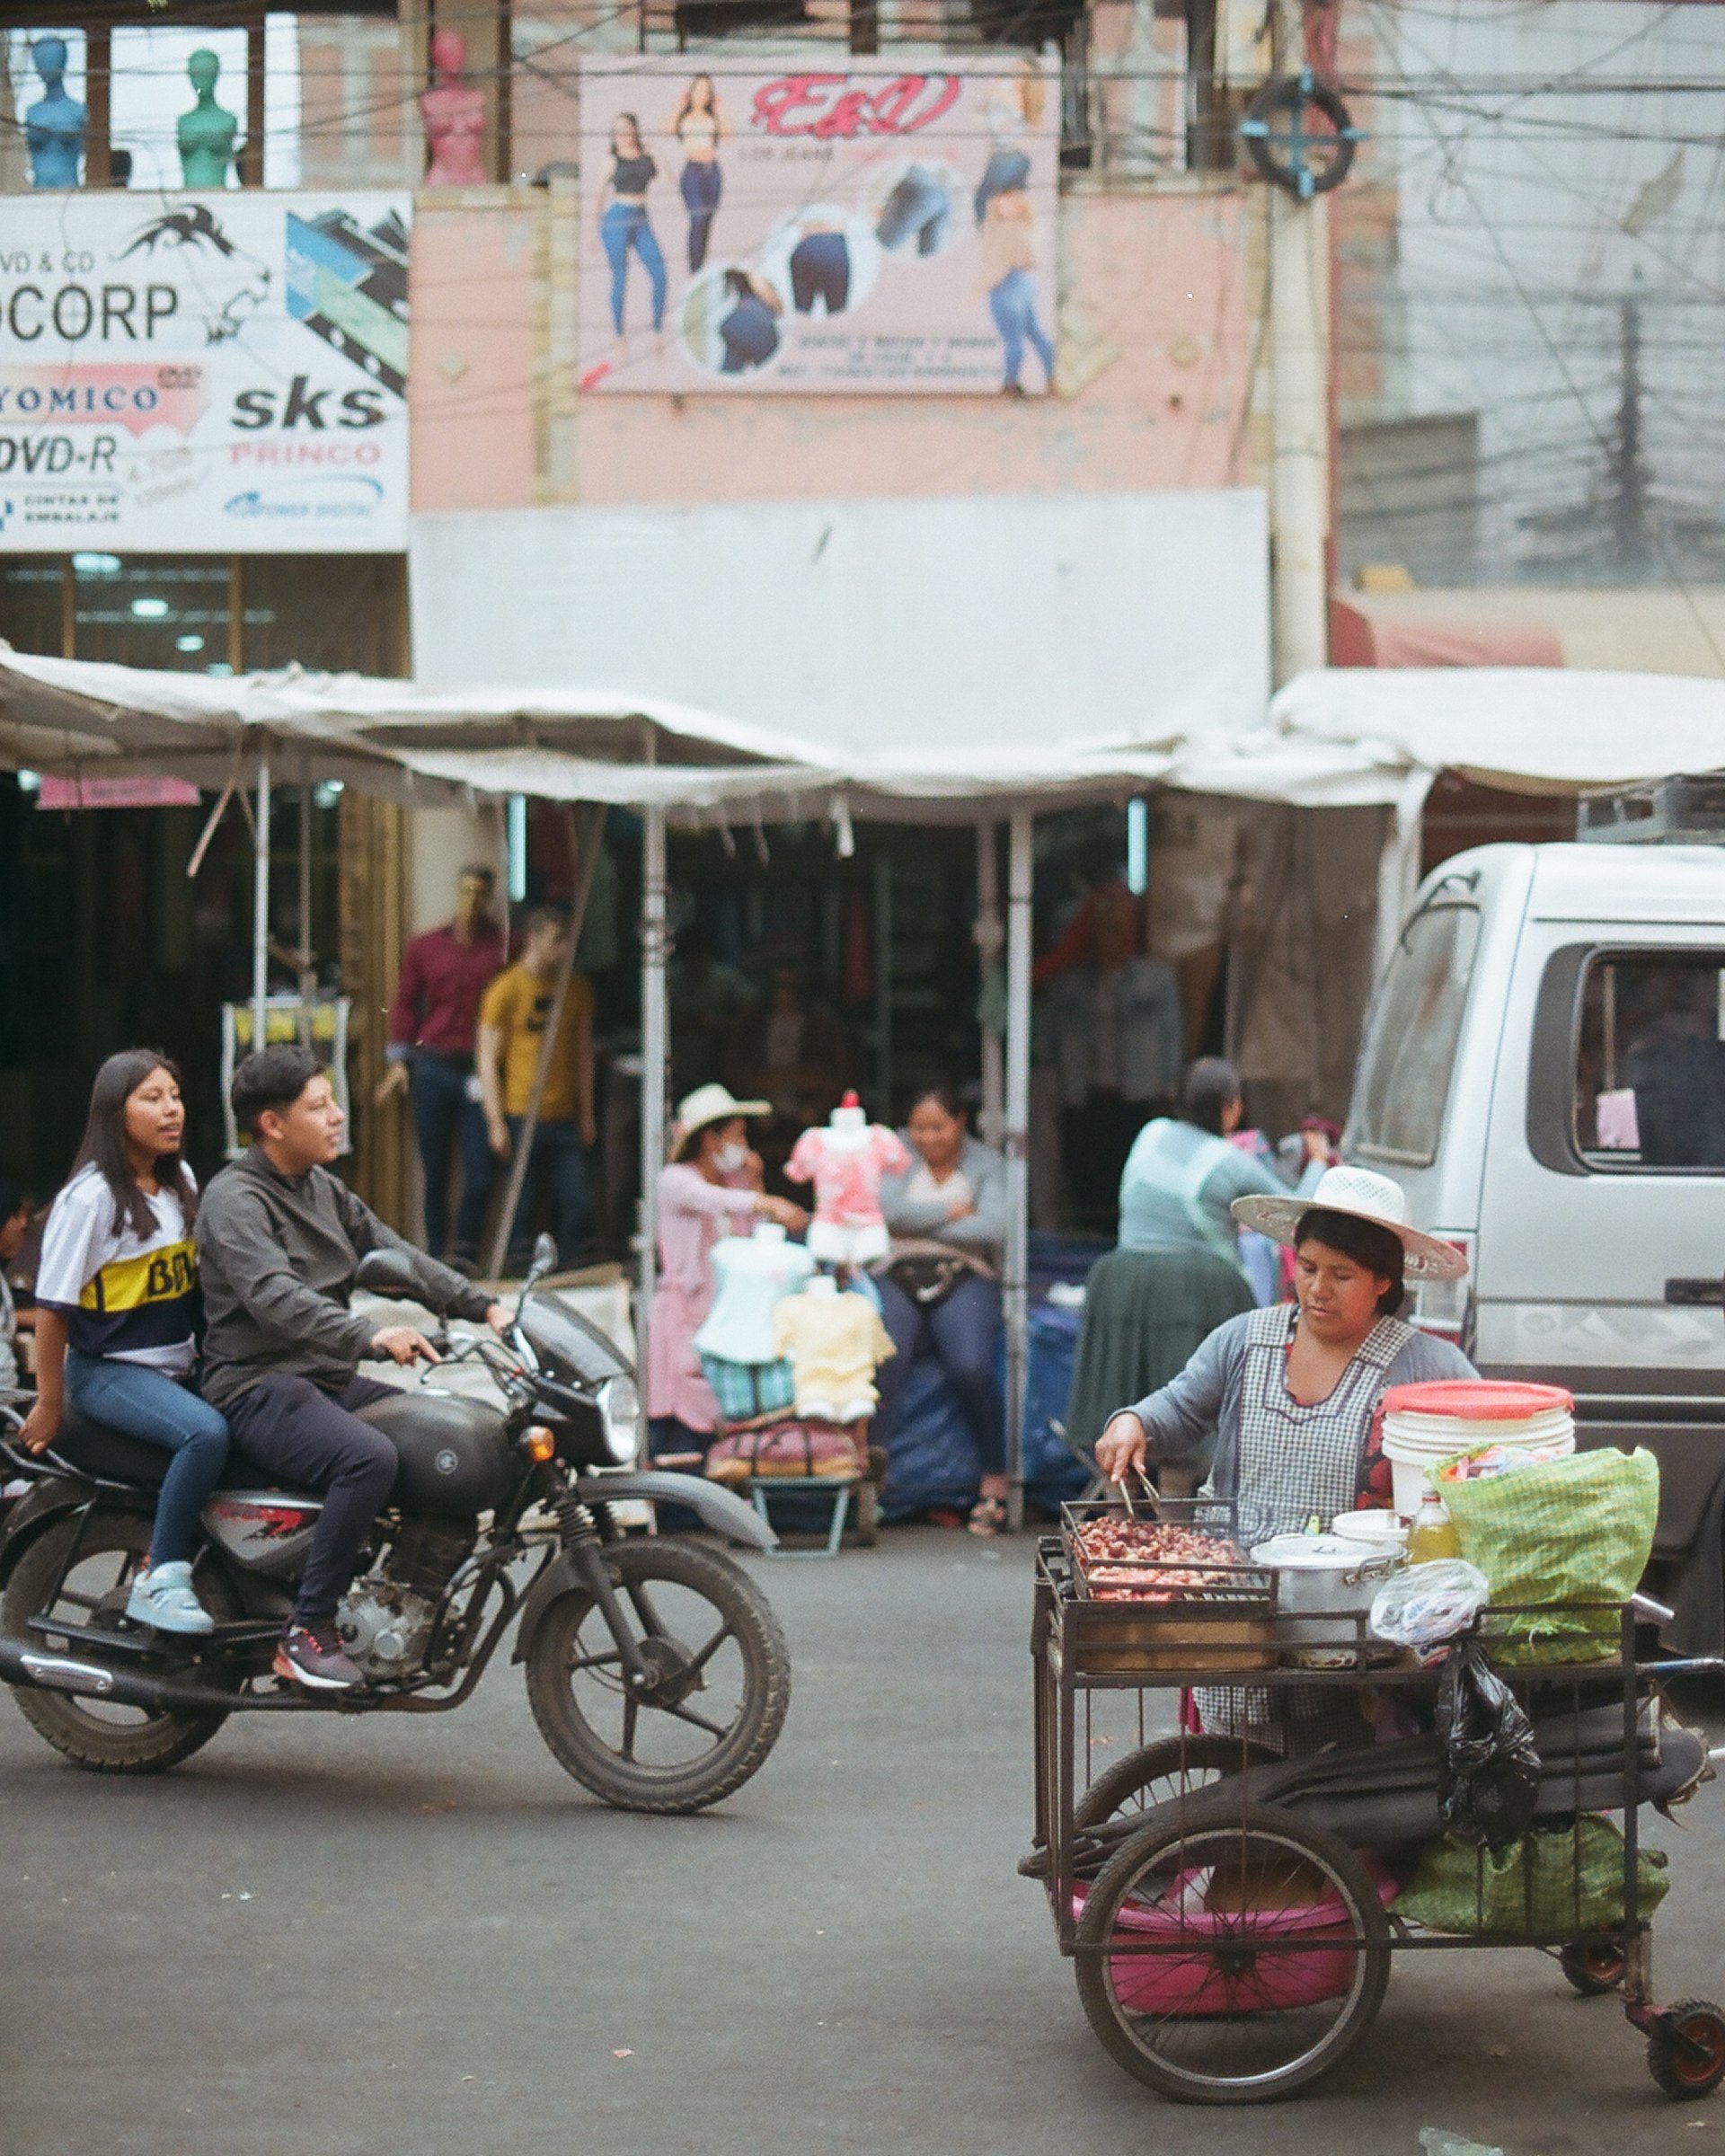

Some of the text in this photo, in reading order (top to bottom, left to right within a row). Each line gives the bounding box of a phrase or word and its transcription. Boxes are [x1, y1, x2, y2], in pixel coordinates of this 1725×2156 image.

[39, 252, 52, 272] &
[0, 284, 178, 341] CORP
[230, 374, 385, 430] sks
[230, 442, 381, 467] PRINCO
